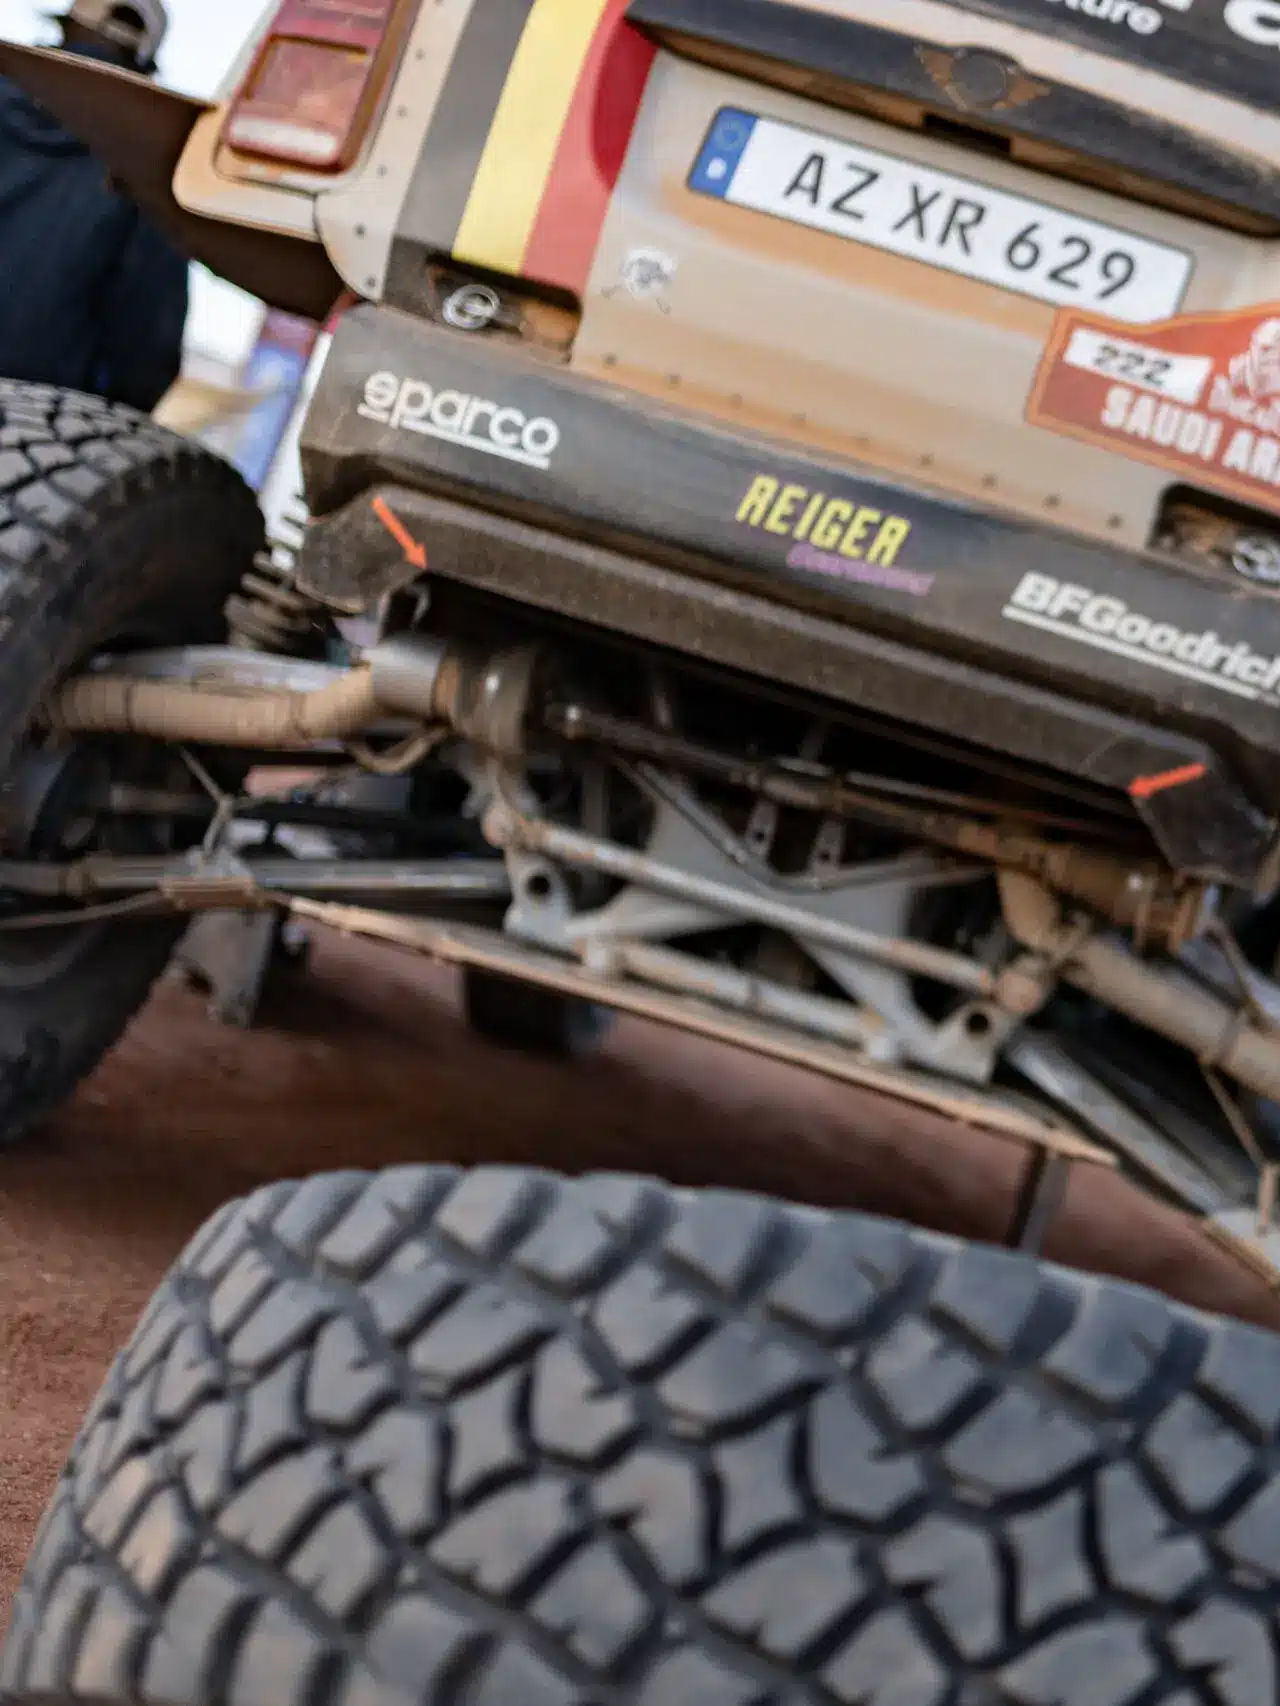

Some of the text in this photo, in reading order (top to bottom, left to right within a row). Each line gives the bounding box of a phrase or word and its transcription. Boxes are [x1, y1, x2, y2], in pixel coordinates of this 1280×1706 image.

[783, 151, 1137, 300] AZ XR 629
[1092, 342, 1172, 387] 222
[360, 370, 560, 463] sparco
[1100, 386, 1223, 460] SAUDI
[734, 472, 912, 569] REIGER
